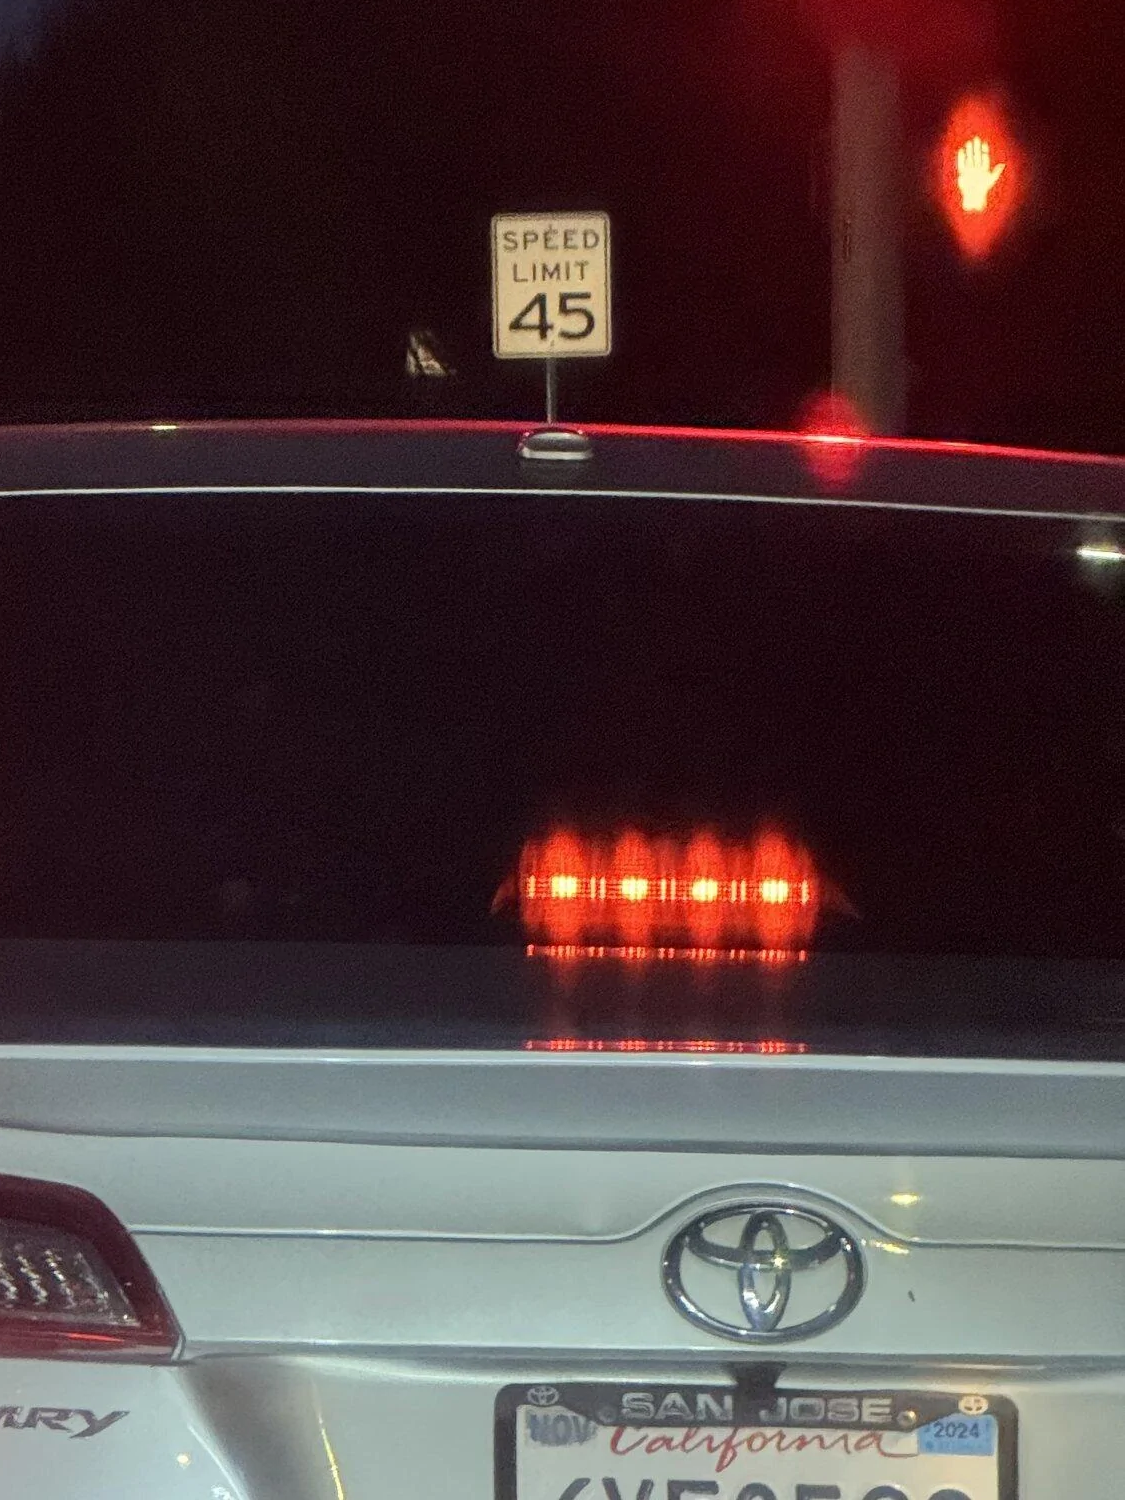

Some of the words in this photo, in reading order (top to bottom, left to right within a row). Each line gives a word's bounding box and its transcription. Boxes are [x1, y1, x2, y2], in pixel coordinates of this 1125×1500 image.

[503, 228, 600, 251] SPEED
[513, 260, 589, 282] LIMIT
[509, 292, 595, 340] 45
[621, 1392, 733, 1421] SAN
[759, 1396, 893, 1423] JOSE
[933, 1421, 980, 1439] 2024
[610, 1426, 919, 1473] California
